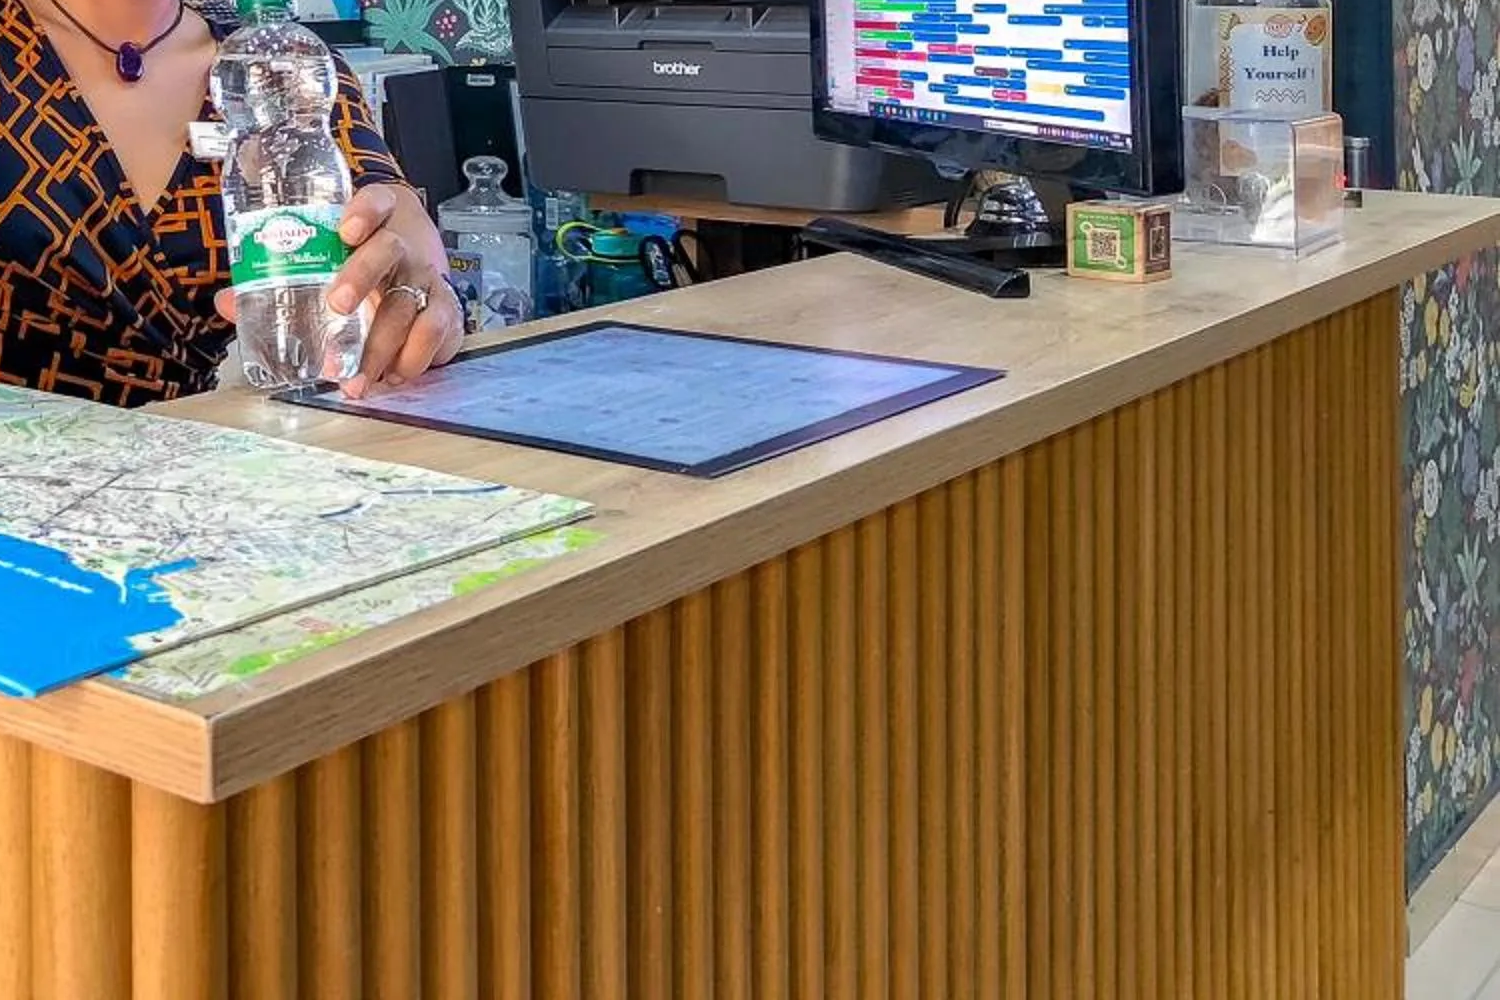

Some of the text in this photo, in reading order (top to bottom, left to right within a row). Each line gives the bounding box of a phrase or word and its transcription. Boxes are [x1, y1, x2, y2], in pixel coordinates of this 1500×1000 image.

[1263, 45, 1299, 60] Help
[653, 61, 701, 75] brother
[1244, 67, 1307, 80] Yourself
